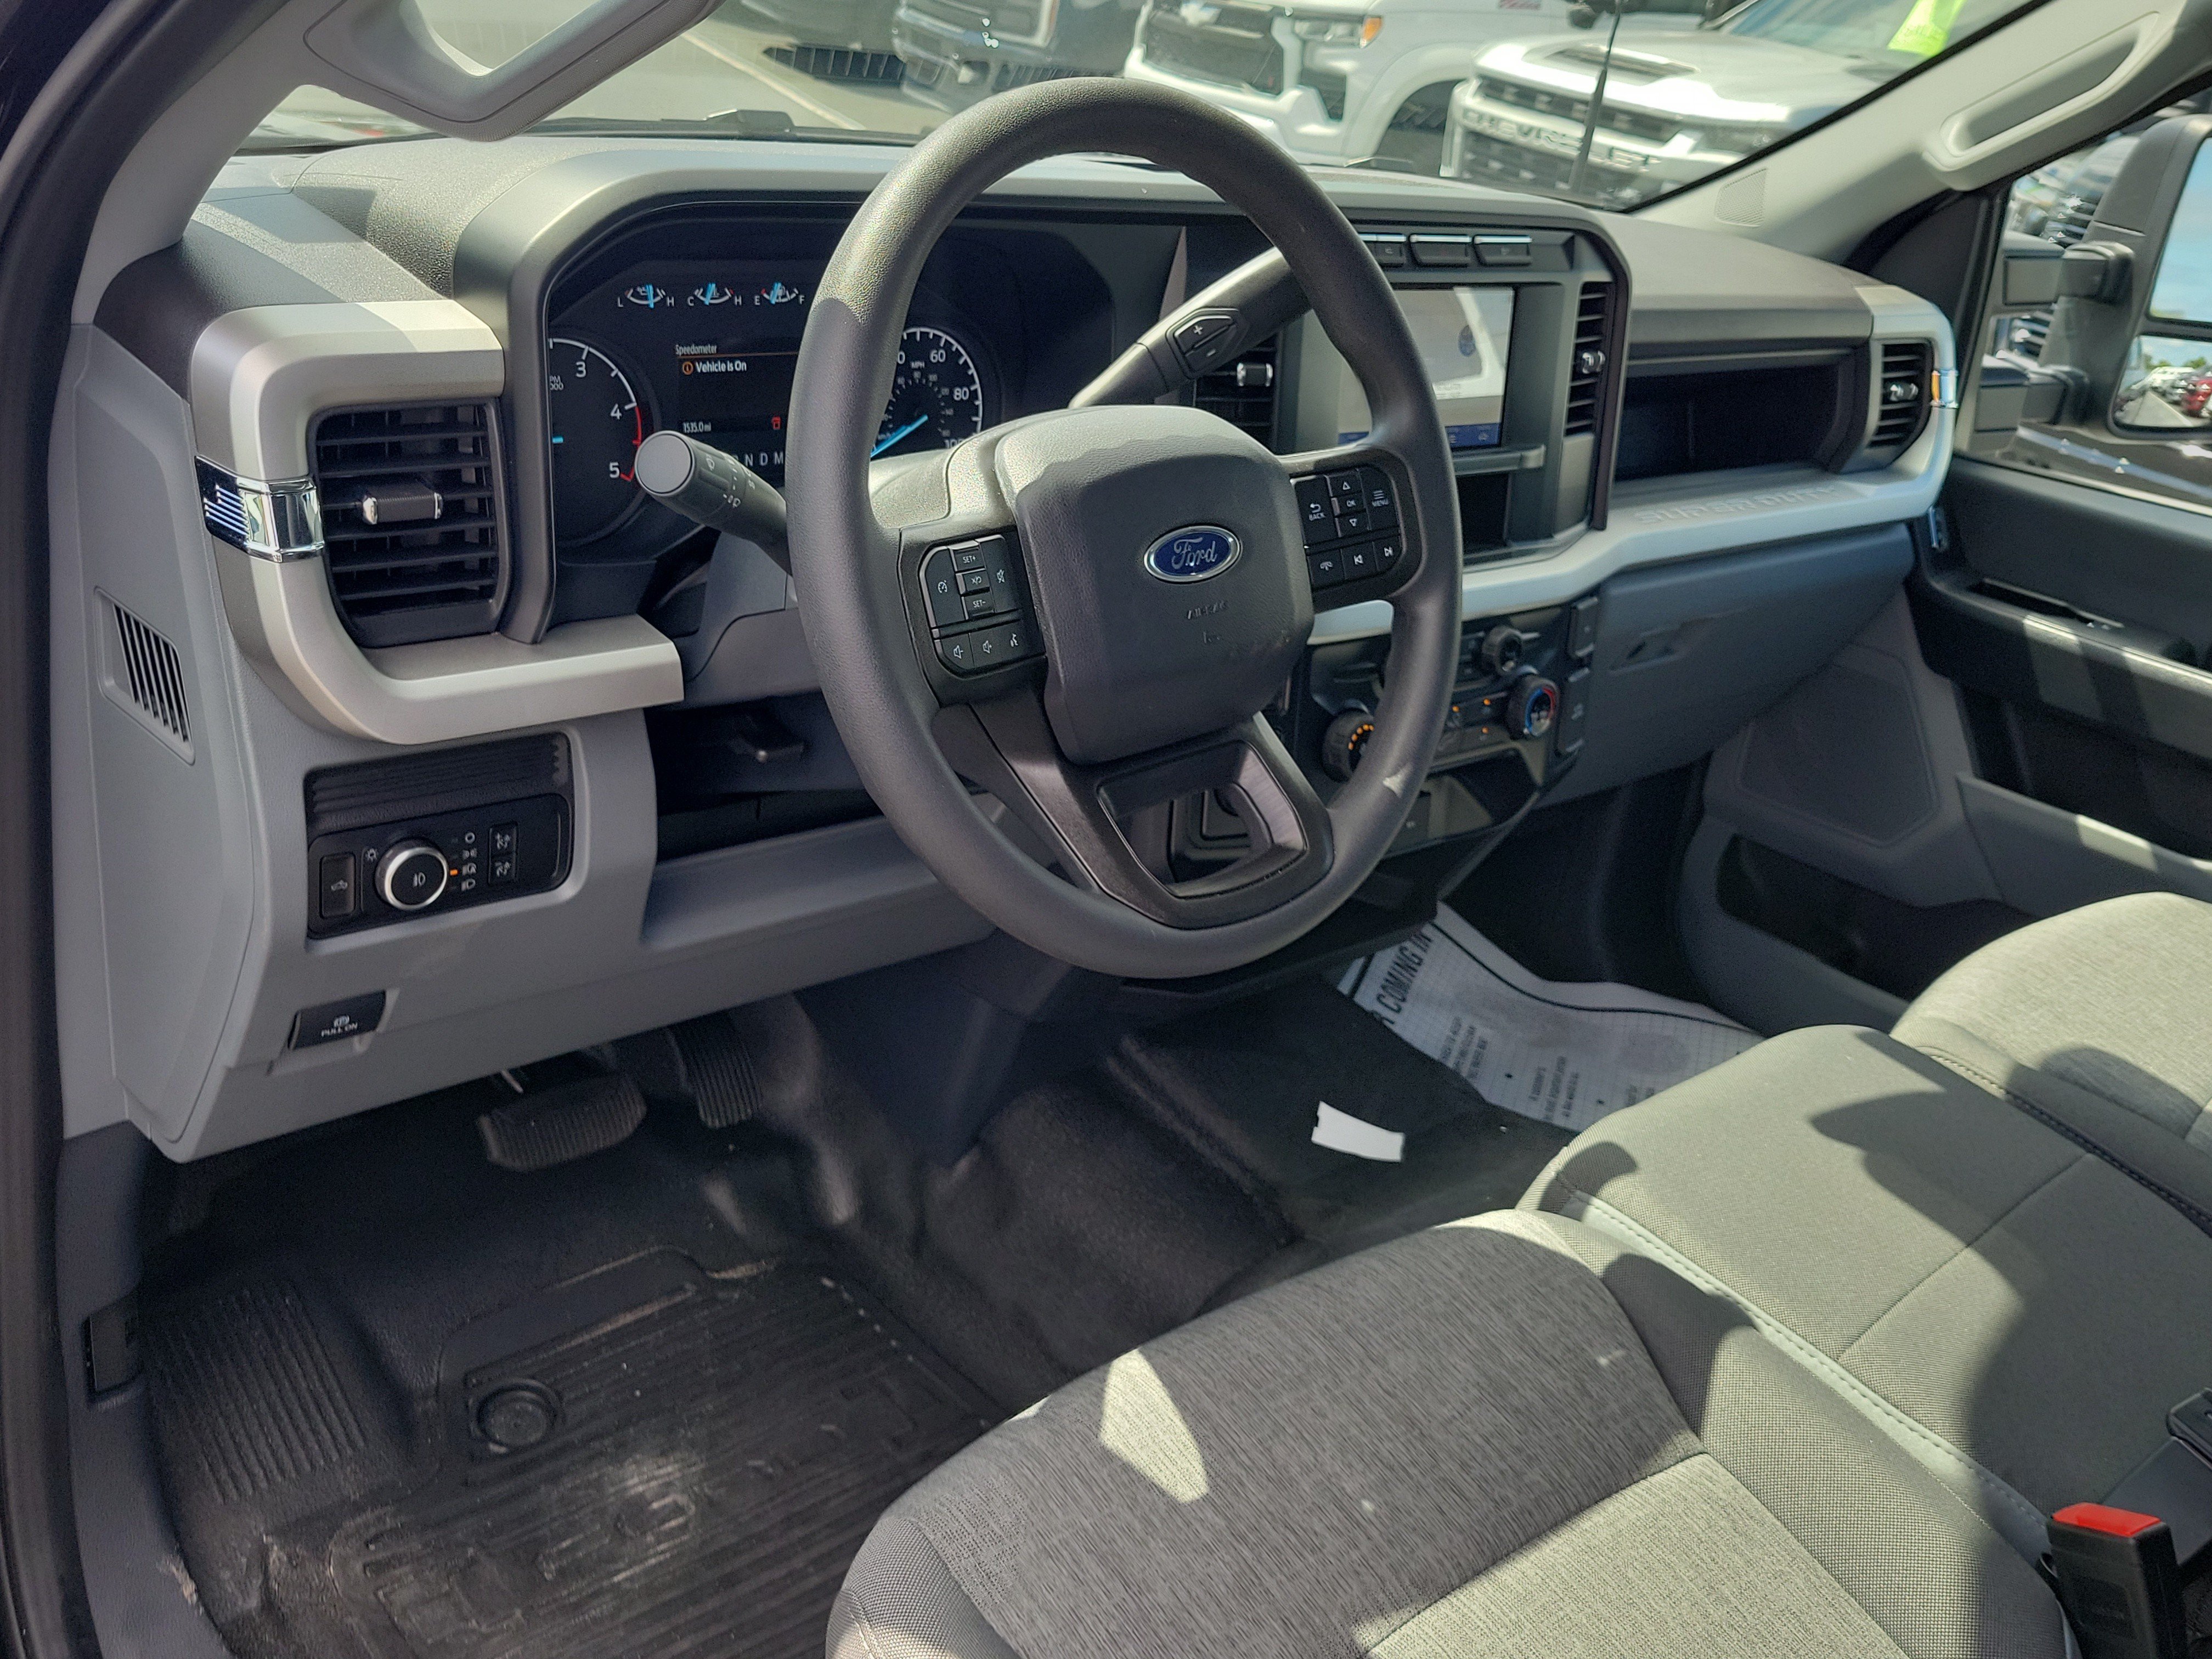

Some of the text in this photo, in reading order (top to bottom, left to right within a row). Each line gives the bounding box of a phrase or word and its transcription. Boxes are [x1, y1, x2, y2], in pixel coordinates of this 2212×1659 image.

[618, 297, 624, 308] L
[667, 296, 674, 307] H
[688, 297, 695, 306] C
[735, 295, 742, 306] H
[755, 295, 760, 306] E
[799, 295, 805, 304] F
[675, 344, 717, 356] Speedometer
[930, 349, 946, 363] 60
[898, 351, 905, 364] 0
[575, 361, 586, 378] 3
[696, 360, 726, 373] Vehicle
[735, 360, 747, 371] On
[953, 387, 969, 401] 80
[611, 403, 622, 420] 4
[745, 451, 783, 466] N D M
[609, 462, 620, 478] 5
[1372, 499, 1389, 507] MENU
[1309, 512, 1325, 521] BACK
[963, 555, 976, 563] SET+
[1171, 537, 1218, 569] Ford
[1376, 945, 1424, 1014] COMING
[345, 1022, 358, 1032] ON
